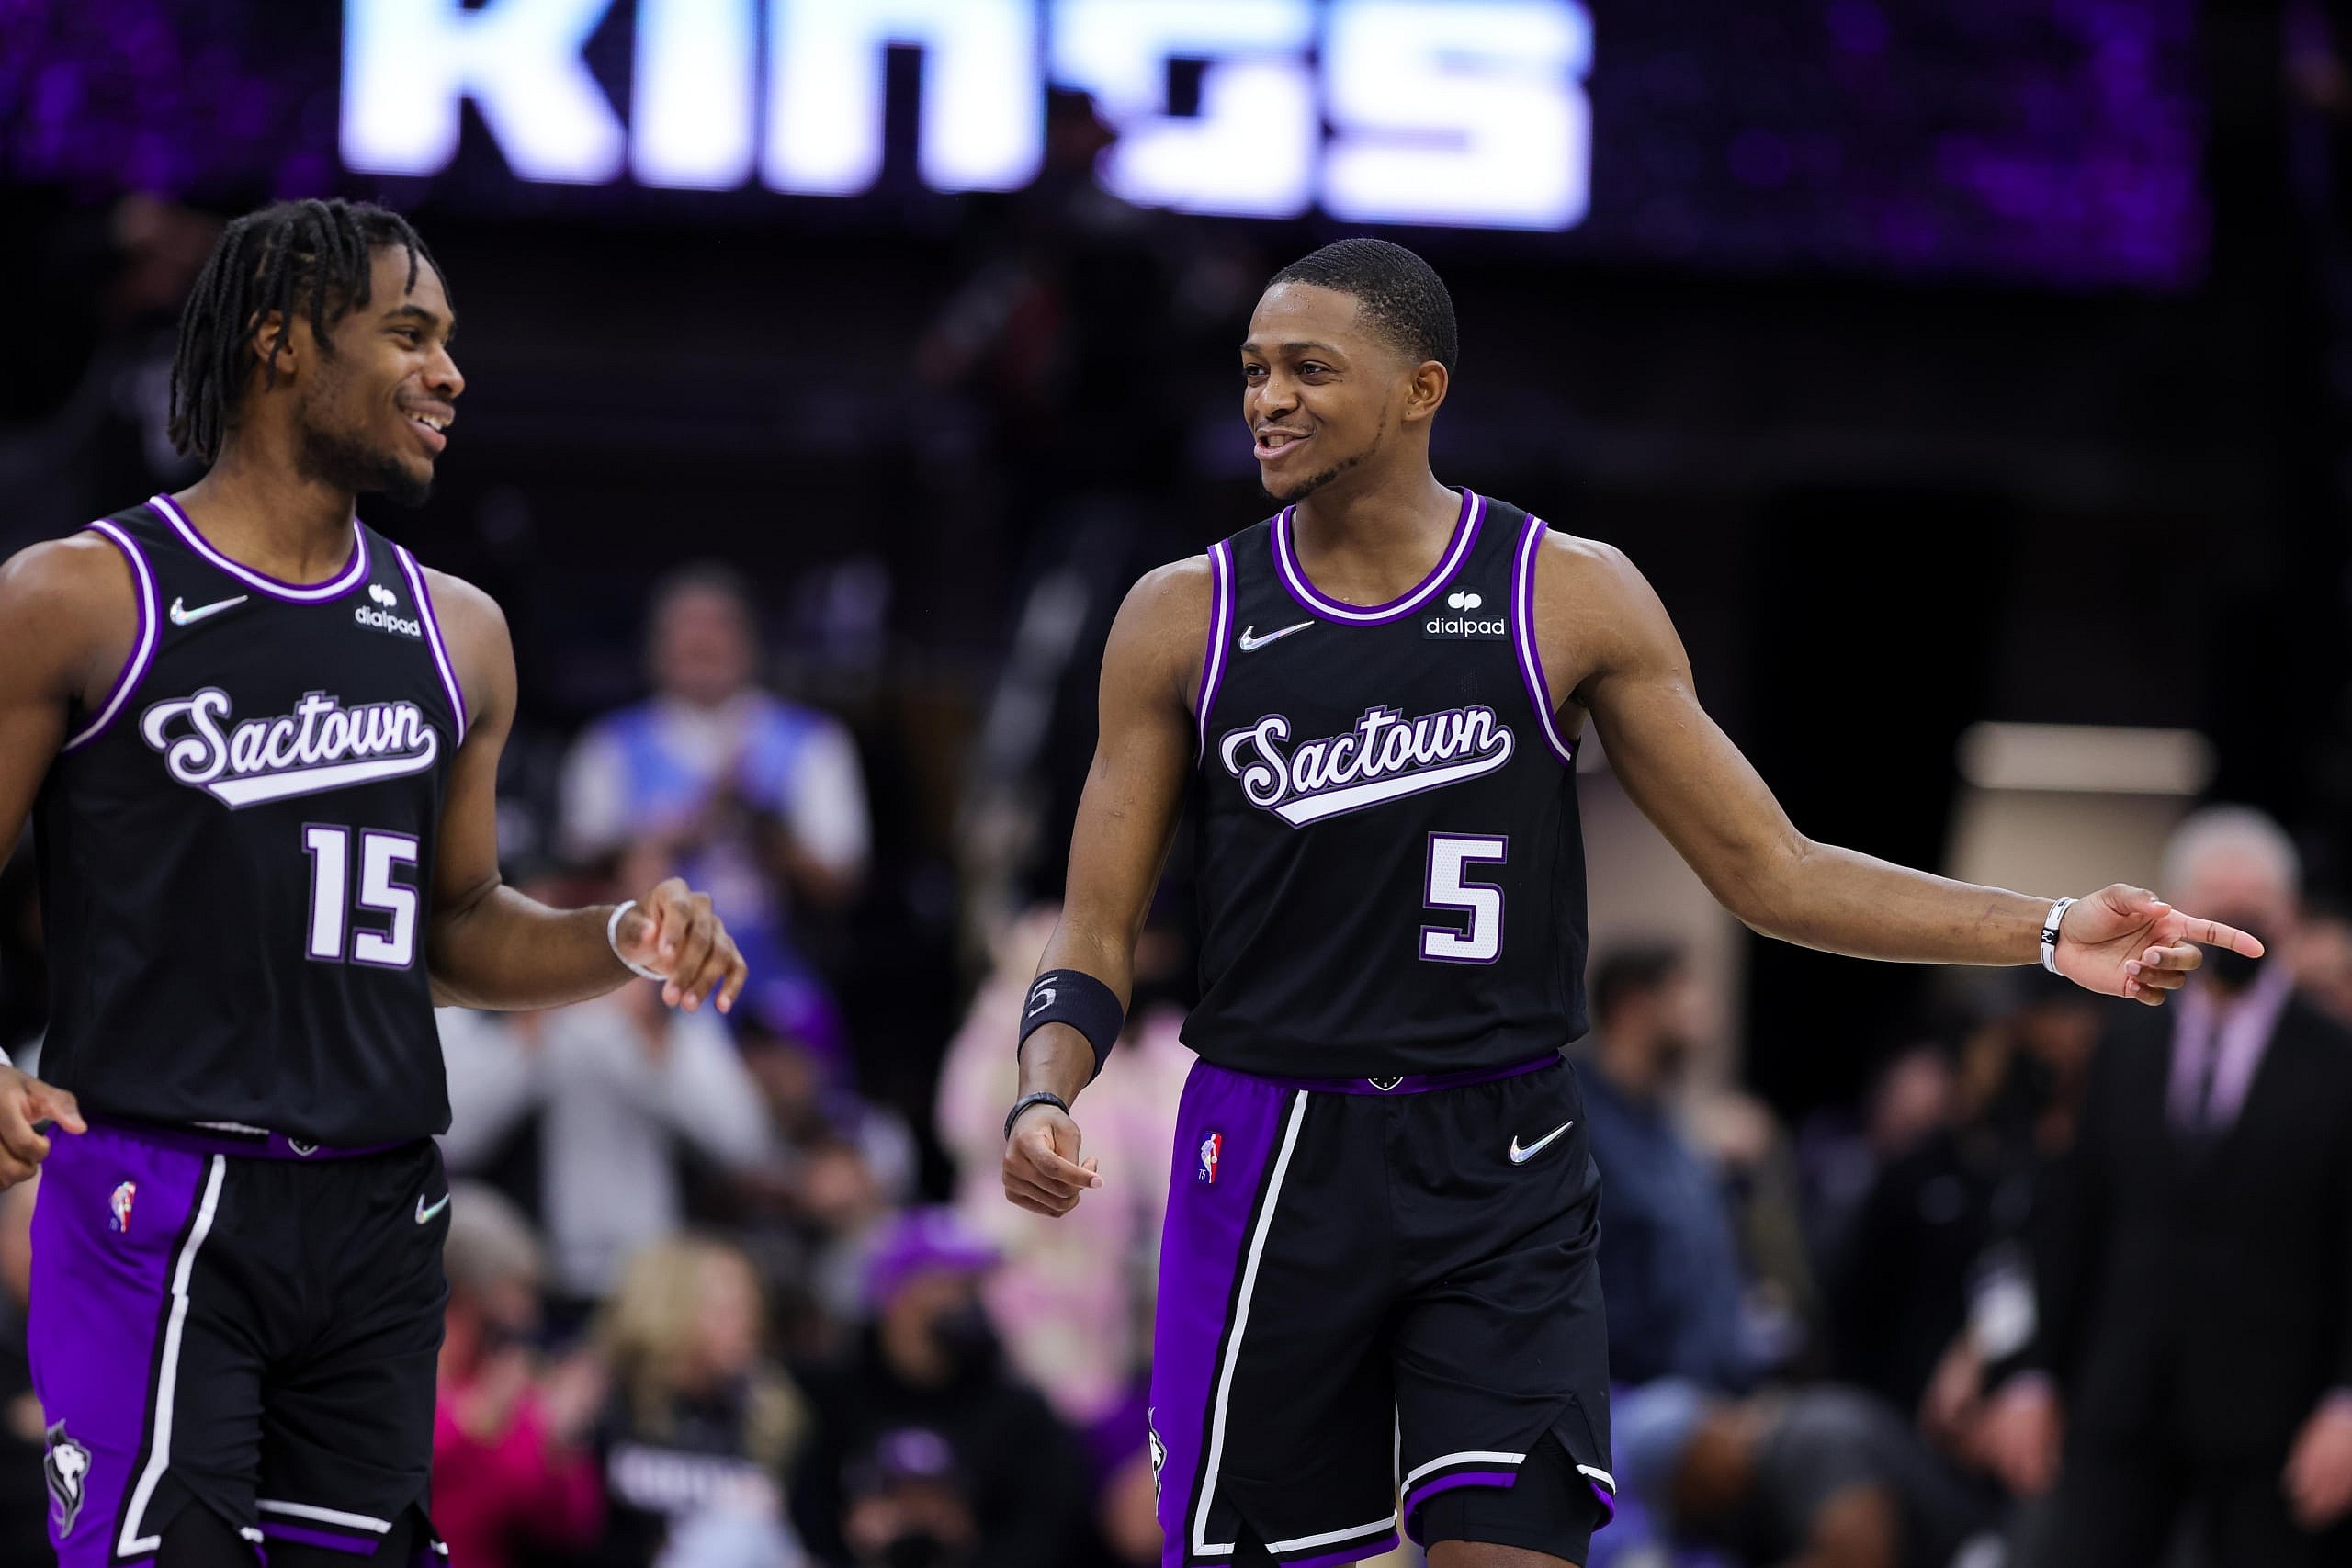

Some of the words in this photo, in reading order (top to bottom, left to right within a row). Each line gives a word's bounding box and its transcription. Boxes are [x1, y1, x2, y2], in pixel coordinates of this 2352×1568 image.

[355, 605, 422, 637] dialpad
[1426, 617, 1505, 637] dialpad
[140, 686, 438, 809] Sactown
[1219, 705, 1515, 825] Sactown
[301, 822, 420, 971] 15
[1419, 831, 1509, 965] 5
[1027, 976, 1058, 1018] 5
